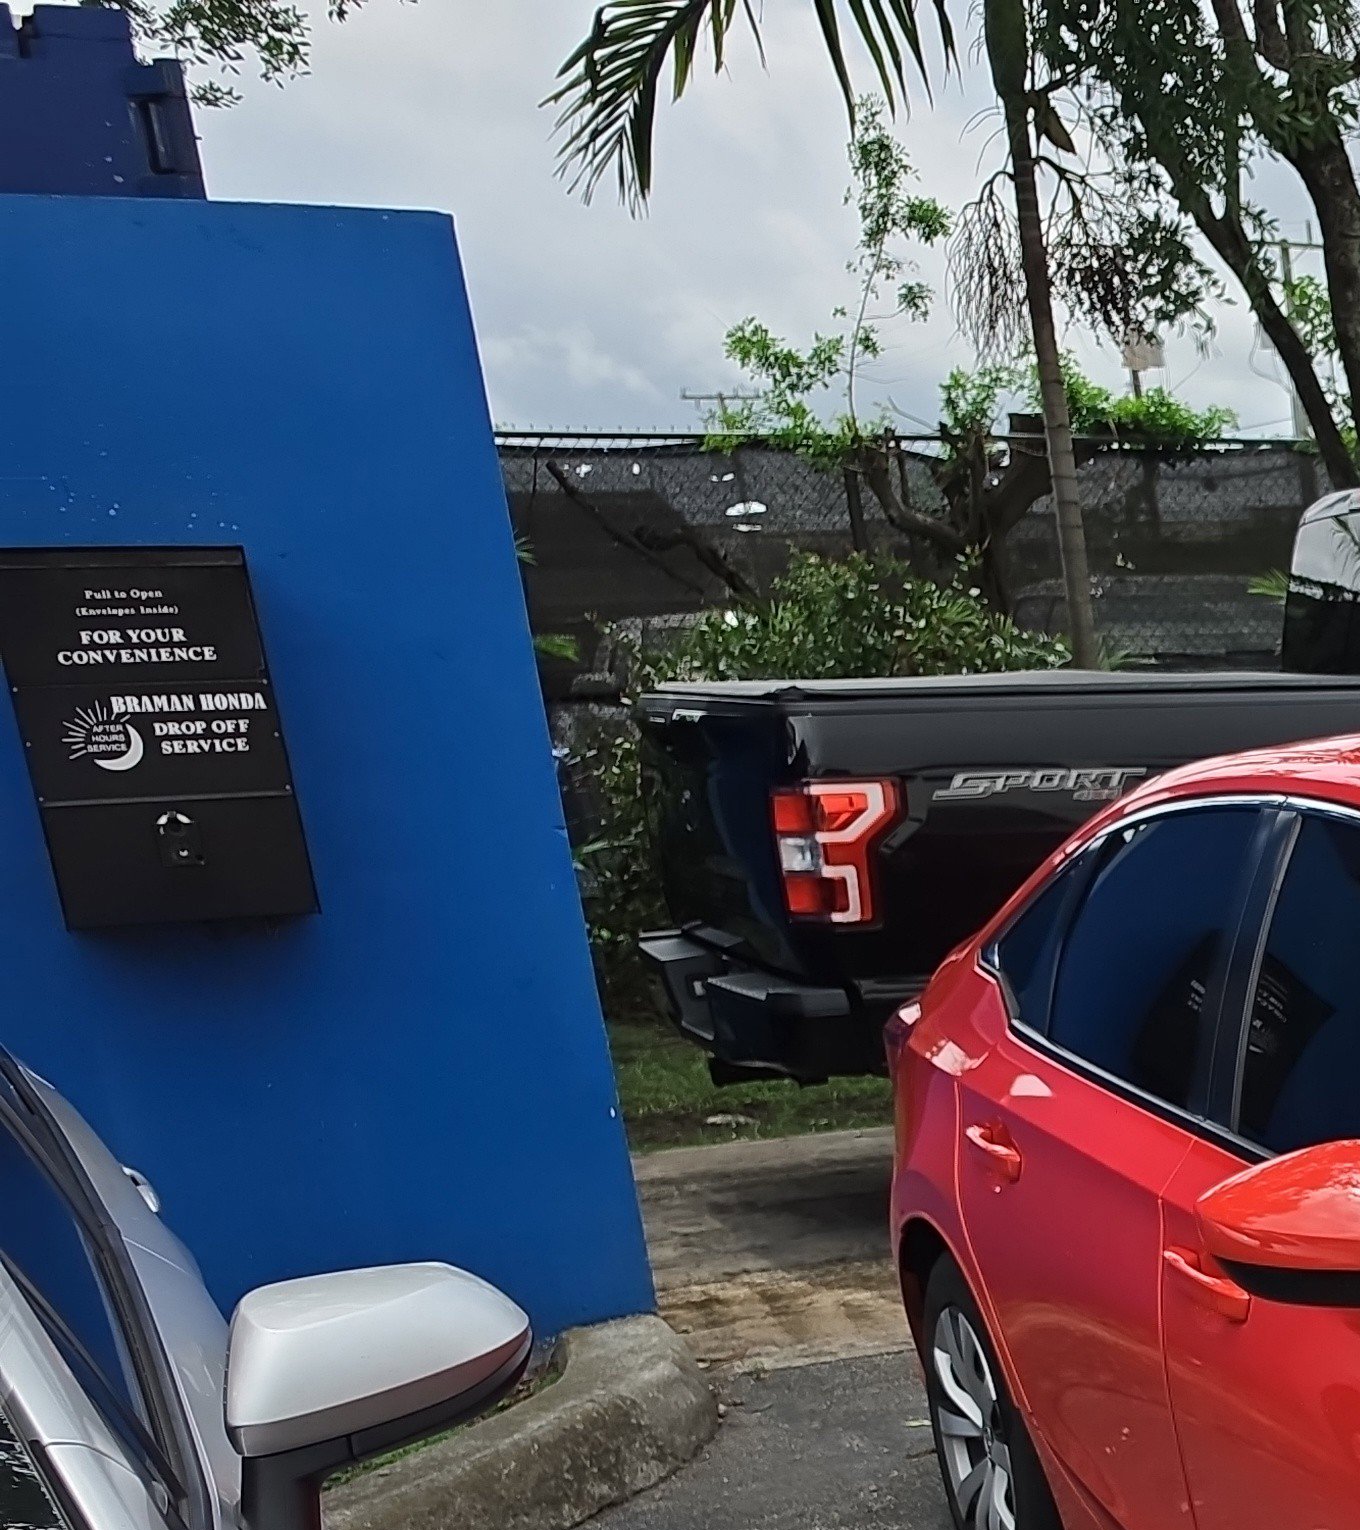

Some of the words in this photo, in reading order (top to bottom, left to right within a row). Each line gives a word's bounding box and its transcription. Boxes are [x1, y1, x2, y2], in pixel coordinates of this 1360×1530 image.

[84, 589, 112, 600] Pull
[114, 590, 127, 599] to
[130, 588, 163, 600] Open
[140, 604, 178, 615] Inside)
[79, 629, 124, 645] FOR
[125, 627, 187, 643] YOUR
[57, 645, 217, 666] CONVENIENCE
[110, 694, 195, 714] BRAMAN
[199, 692, 267, 711] HONDA
[92, 724, 125, 733] AFTER
[153, 721, 207, 736] DROP
[211, 718, 250, 734] OFF
[91, 734, 125, 743] HOURS
[160, 737, 250, 755] SERVICE
[86, 743, 128, 753] SERVICE
[932, 766, 1148, 801] SPORT
